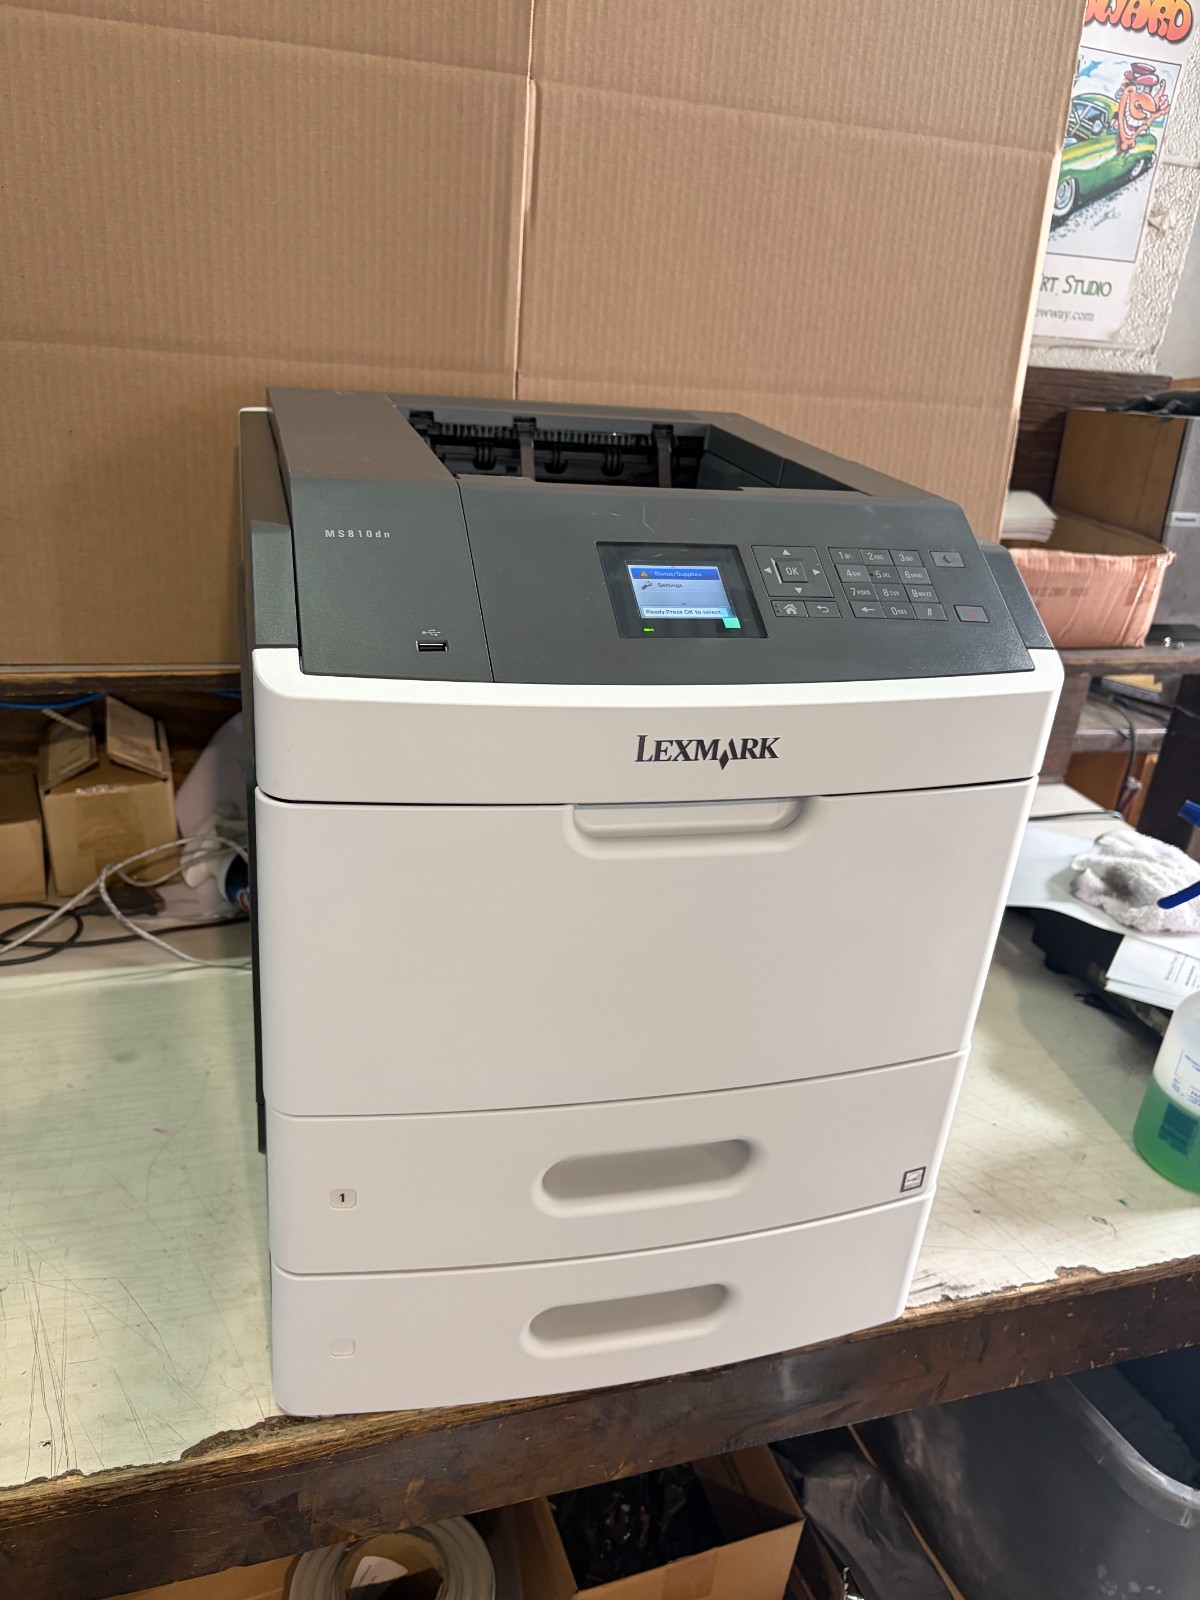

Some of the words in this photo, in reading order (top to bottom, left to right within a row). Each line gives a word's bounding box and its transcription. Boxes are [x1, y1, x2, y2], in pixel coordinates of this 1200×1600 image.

[1084, 0, 1193, 43] WARD
[1039, 274, 1059, 293] RT
[325, 530, 390, 538] MS810dn
[785, 566, 800, 576] OK
[634, 734, 781, 771] LEXMARK
[339, 1193, 345, 1203] 1
